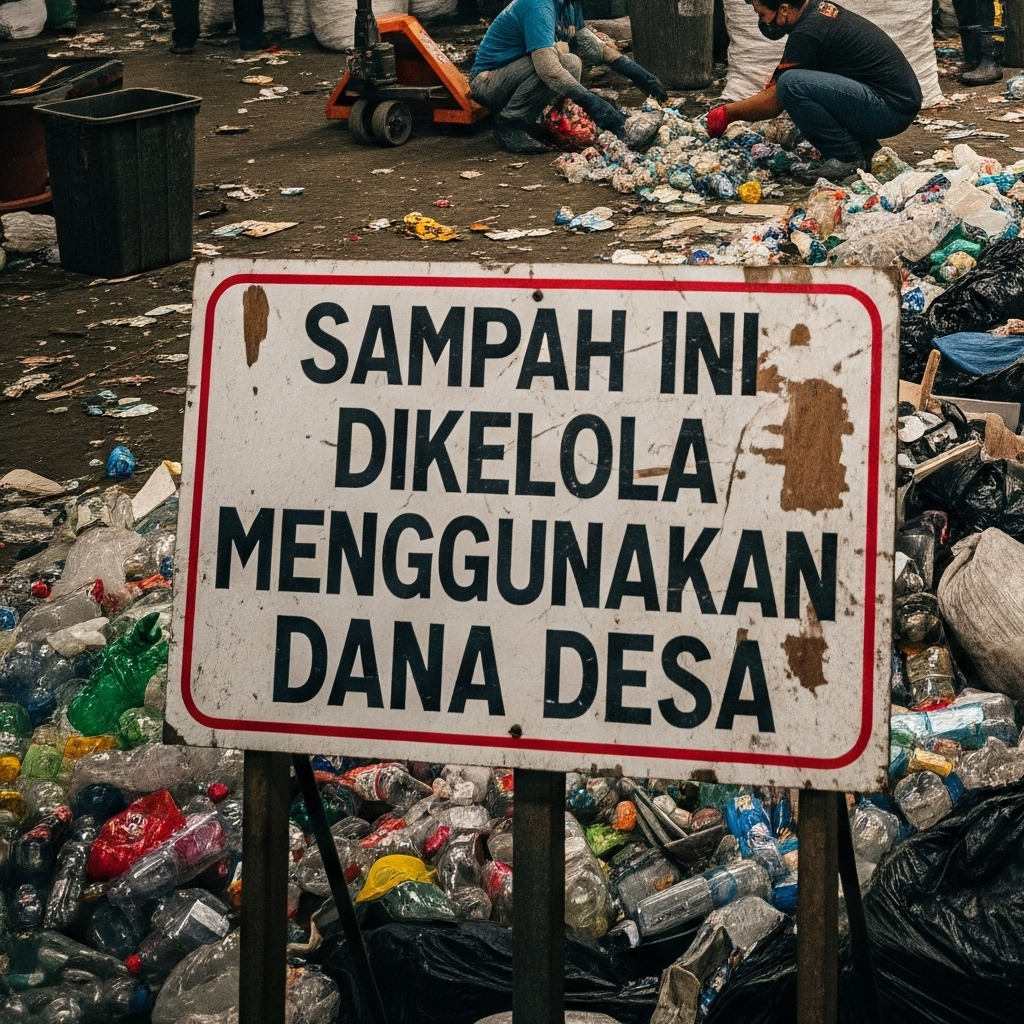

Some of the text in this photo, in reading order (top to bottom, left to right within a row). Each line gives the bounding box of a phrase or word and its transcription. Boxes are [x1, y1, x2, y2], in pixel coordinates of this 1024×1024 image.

[300, 302, 759, 396] SAMPAH INI
[334, 407, 718, 504] DIKELOLA
[215, 506, 838, 622] MENGGUNAKAN
[272, 615, 776, 733] DANA DESA
